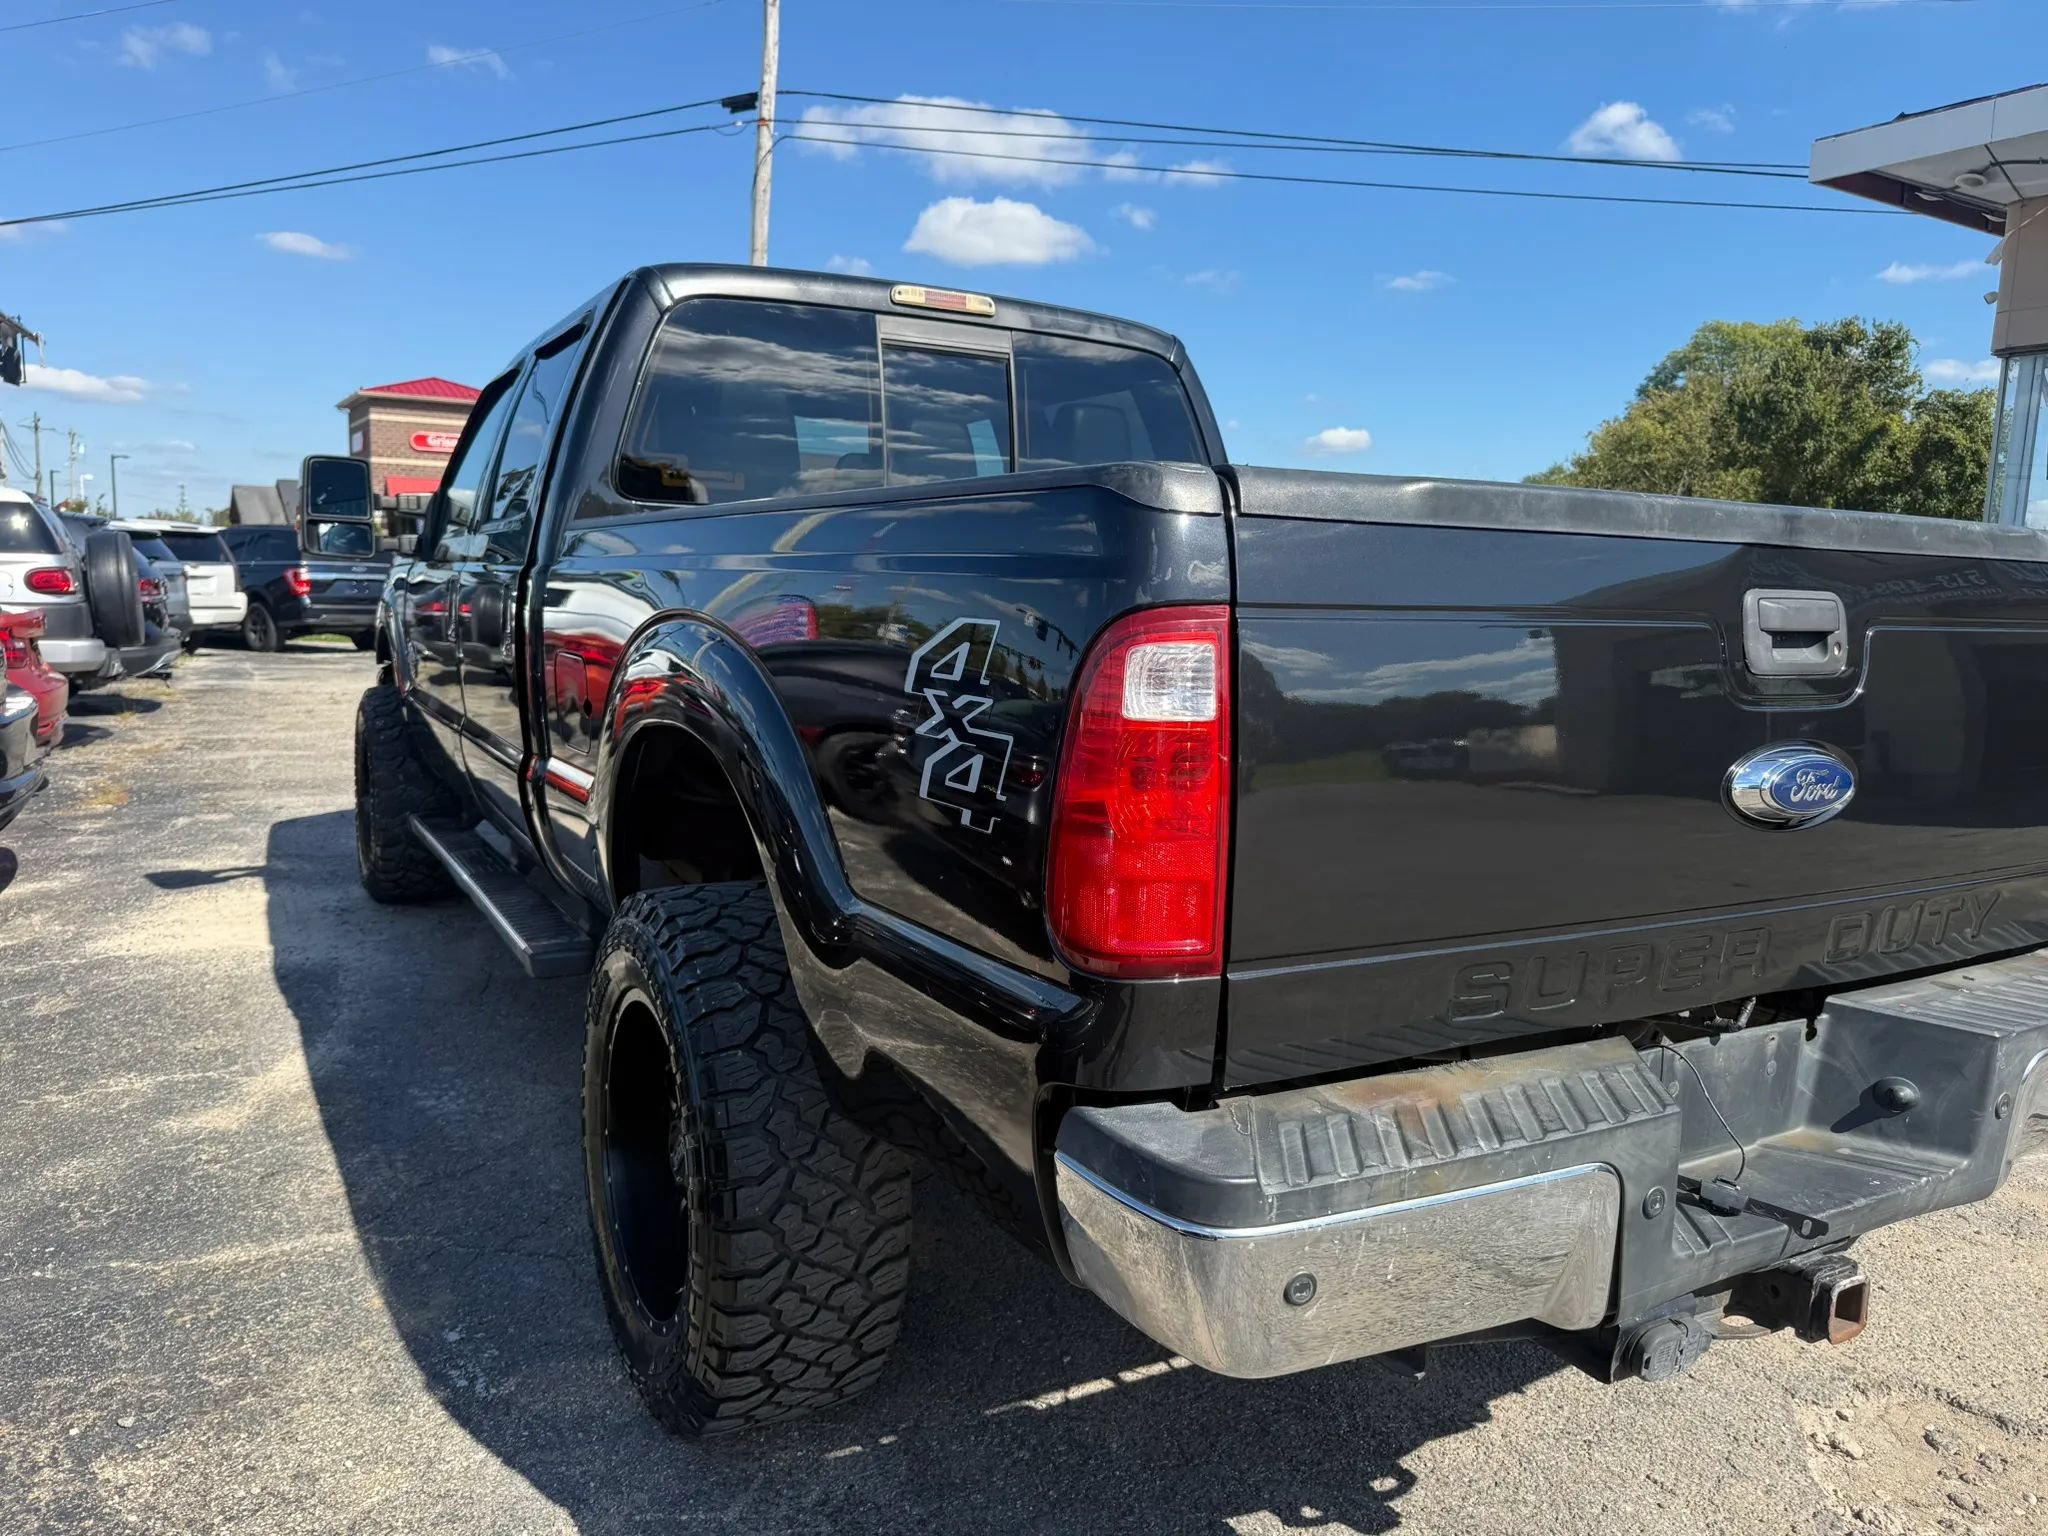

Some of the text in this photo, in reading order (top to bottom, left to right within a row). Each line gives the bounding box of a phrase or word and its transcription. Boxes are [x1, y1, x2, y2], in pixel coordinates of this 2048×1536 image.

[1789, 767, 1842, 802] Ford
[1447, 889, 2003, 1023] SUPER DUTY
